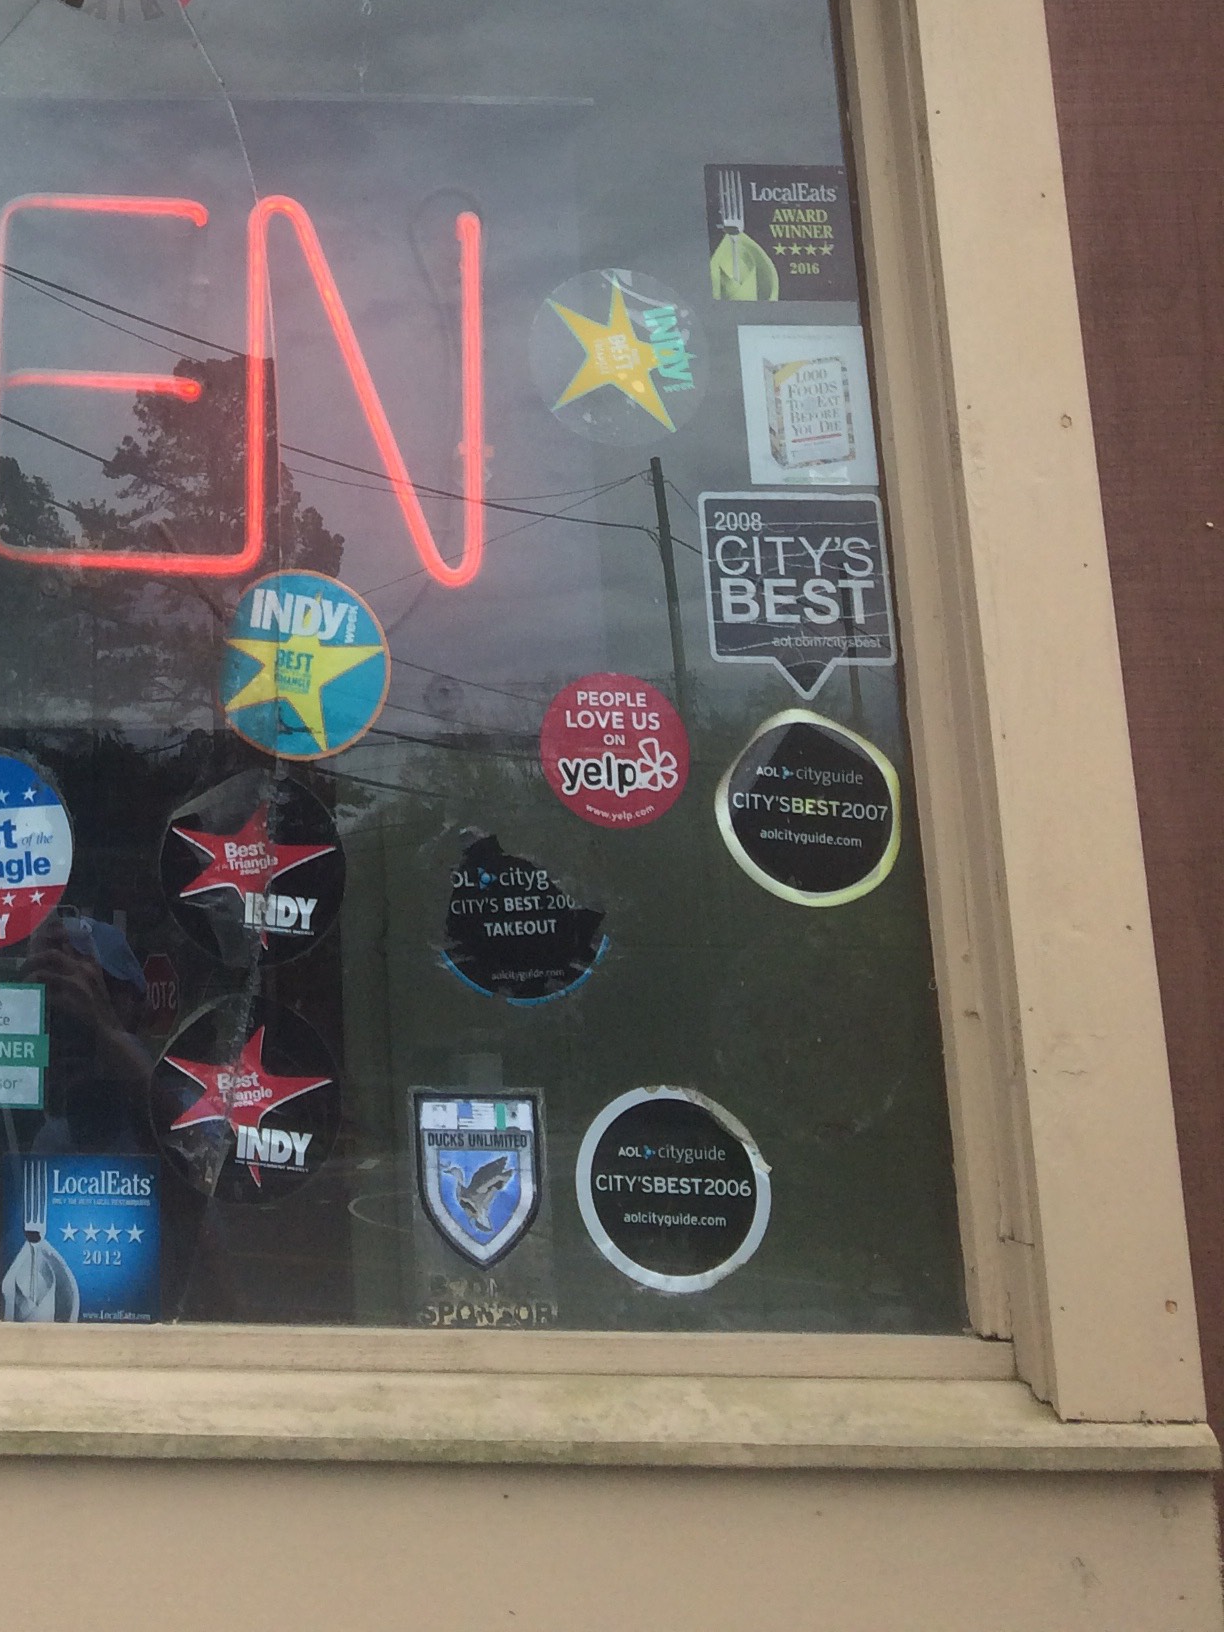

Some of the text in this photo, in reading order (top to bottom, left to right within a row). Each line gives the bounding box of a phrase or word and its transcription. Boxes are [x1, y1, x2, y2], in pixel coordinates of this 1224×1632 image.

[750, 182, 837, 203] LocalEats
[772, 209, 828, 223] AWARD
[769, 225, 834, 240] WINNER
[789, 262, 820, 275] 2016
[714, 511, 762, 531] 2008
[715, 535, 874, 578] CITY'S
[719, 577, 875, 625] BEST
[250, 588, 350, 641] INDY
[577, 691, 647, 708] PEOPLE
[566, 710, 660, 731] LOVE US
[603, 734, 625, 746] ON
[558, 752, 644, 797] yelp
[756, 765, 864, 786] AOL cityguide
[585, 803, 655, 822] www.yelp.com
[19, 832, 33, 847] of
[35, 829, 54, 844] the
[759, 828, 862, 848] aolcityguide.com
[224, 842, 266, 859] Best
[227, 854, 279, 870] Triangle
[450, 870, 475, 888] OL
[244, 892, 318, 929] INDY
[451, 898, 498, 914] CITY'S
[504, 896, 540, 912] BEST
[484, 919, 557, 937] TAKEOUT
[236, 1124, 313, 1166] INDY
[427, 1131, 528, 1148] DUCKS UNLIMITED
[618, 1144, 726, 1164] AOL cityguide
[53, 1169, 151, 1196] LocalEats
[623, 1211, 727, 1227] aolcityguide.com
[83, 1250, 122, 1265] 2012
